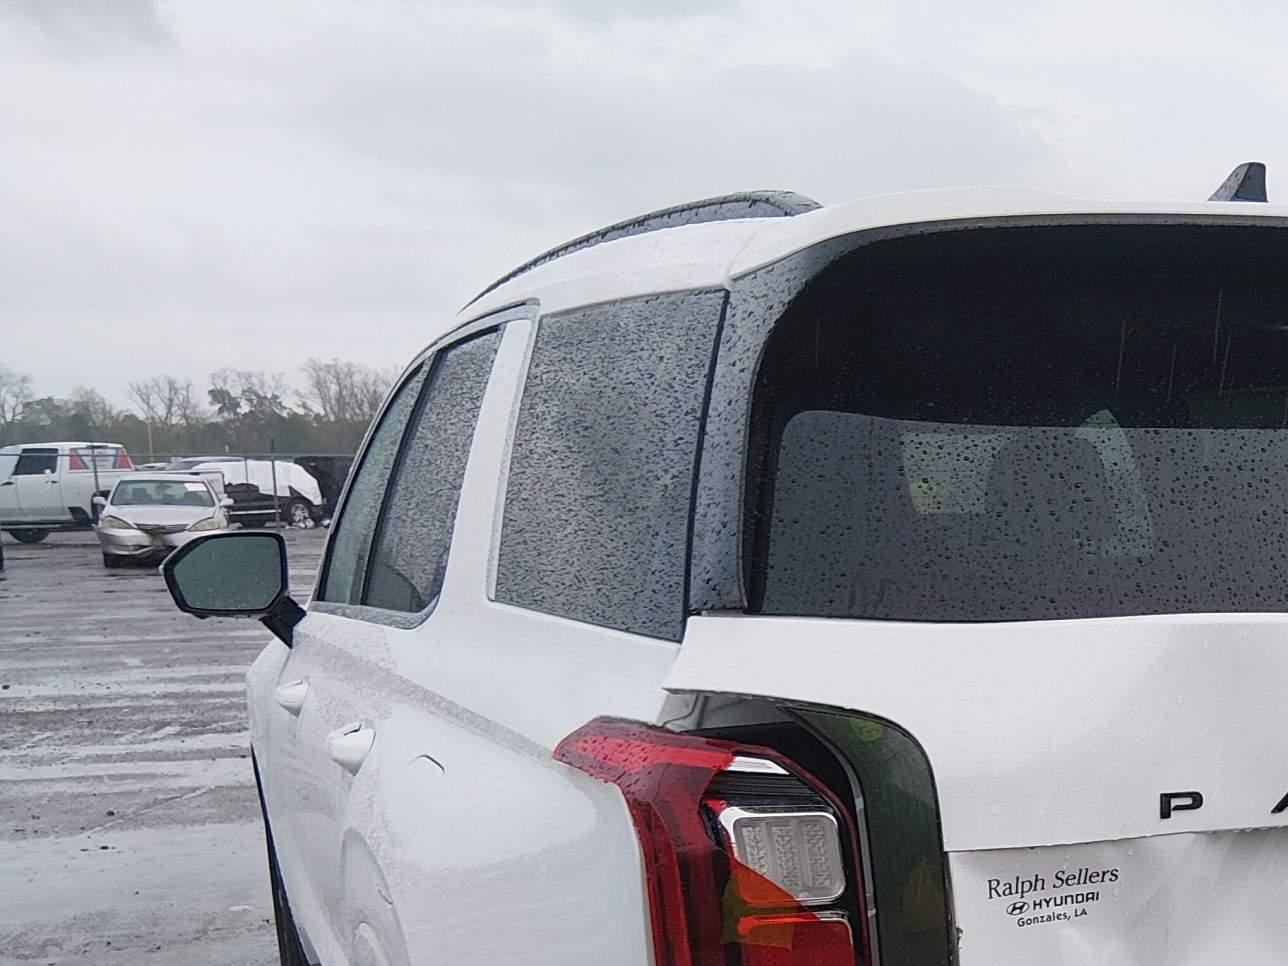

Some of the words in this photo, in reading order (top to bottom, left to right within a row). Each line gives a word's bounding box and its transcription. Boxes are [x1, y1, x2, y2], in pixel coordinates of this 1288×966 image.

[987, 873, 1046, 900] Ralph
[1052, 867, 1119, 889] Sellers
[1032, 891, 1100, 911] HYUNDAI
[1017, 911, 1071, 928] Gonzales,
[1074, 907, 1088, 919] LA
